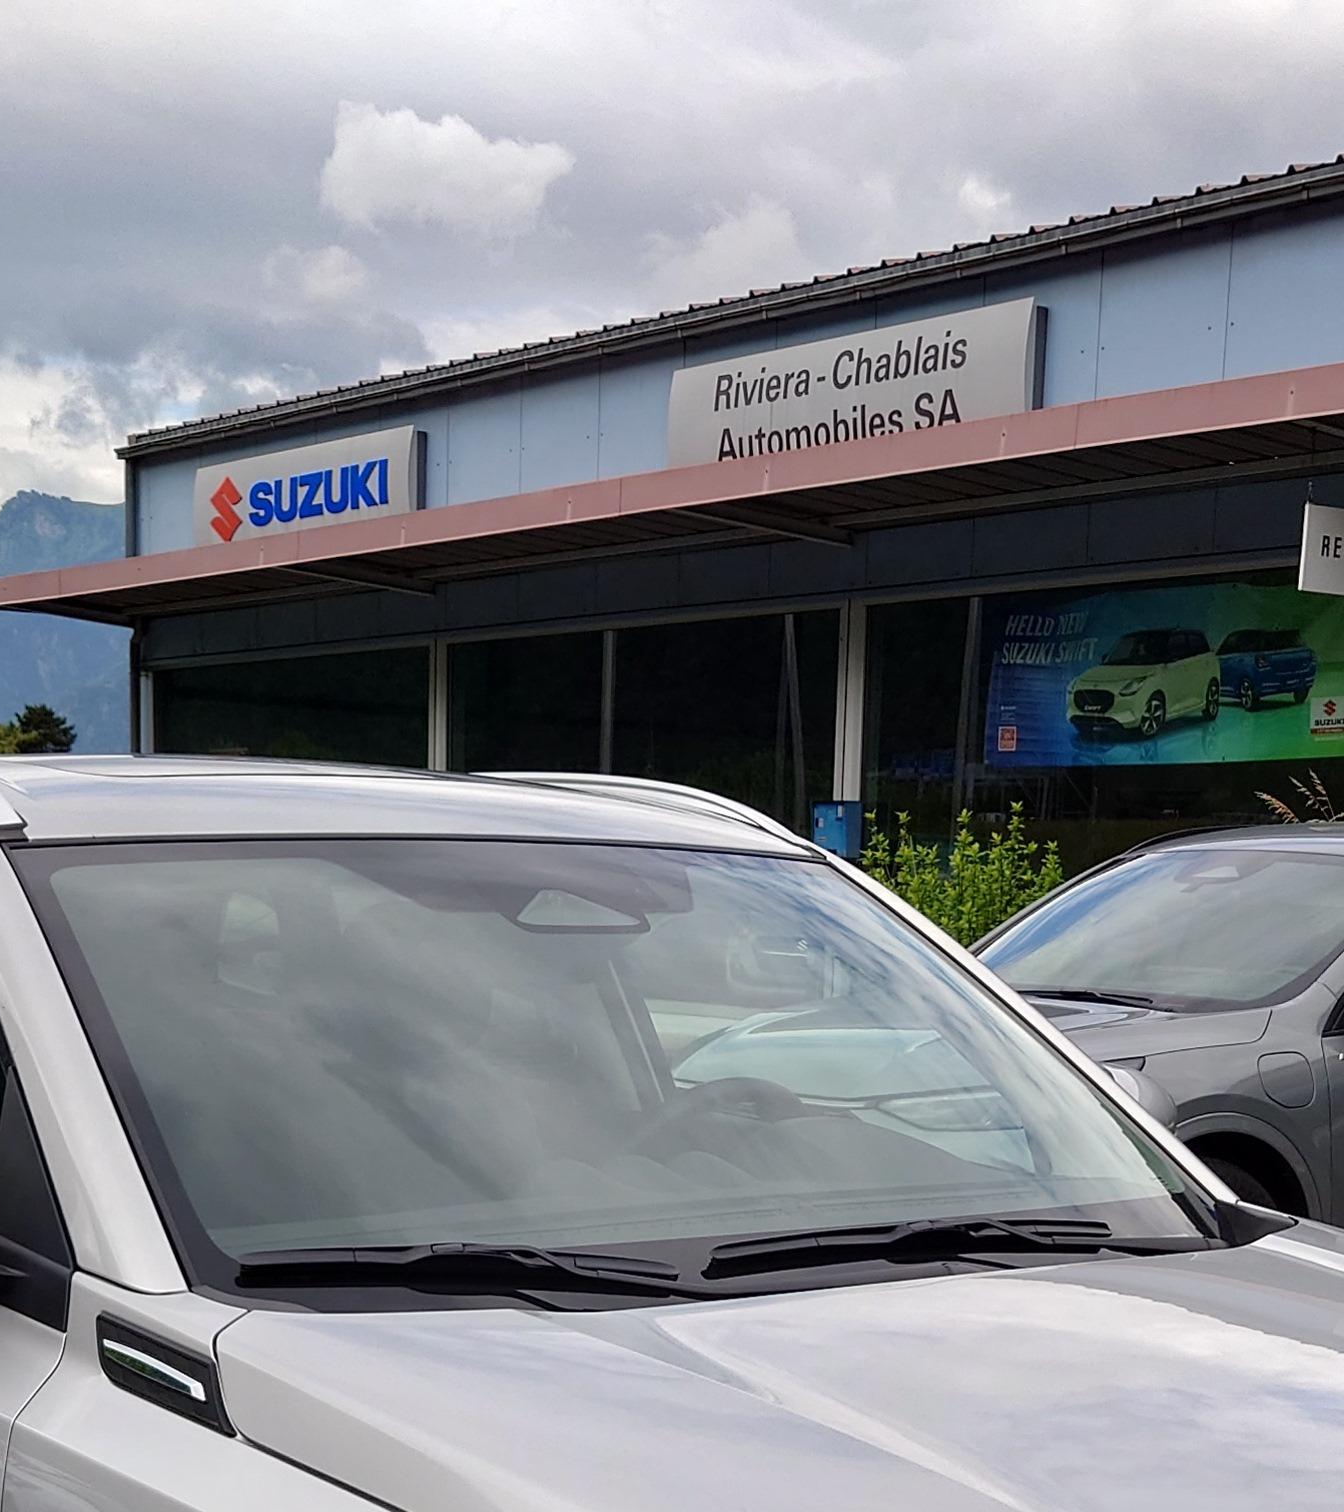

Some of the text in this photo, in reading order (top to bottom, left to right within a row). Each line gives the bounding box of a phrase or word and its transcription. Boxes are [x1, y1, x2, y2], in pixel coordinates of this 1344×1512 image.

[717, 388, 962, 462] Automobiles SA
[248, 457, 390, 528] SUZUKI
[1004, 613, 1055, 637] HELLO
[1001, 641, 1056, 665] SUZUKI
[1314, 718, 1344, 727] SUZUKI
